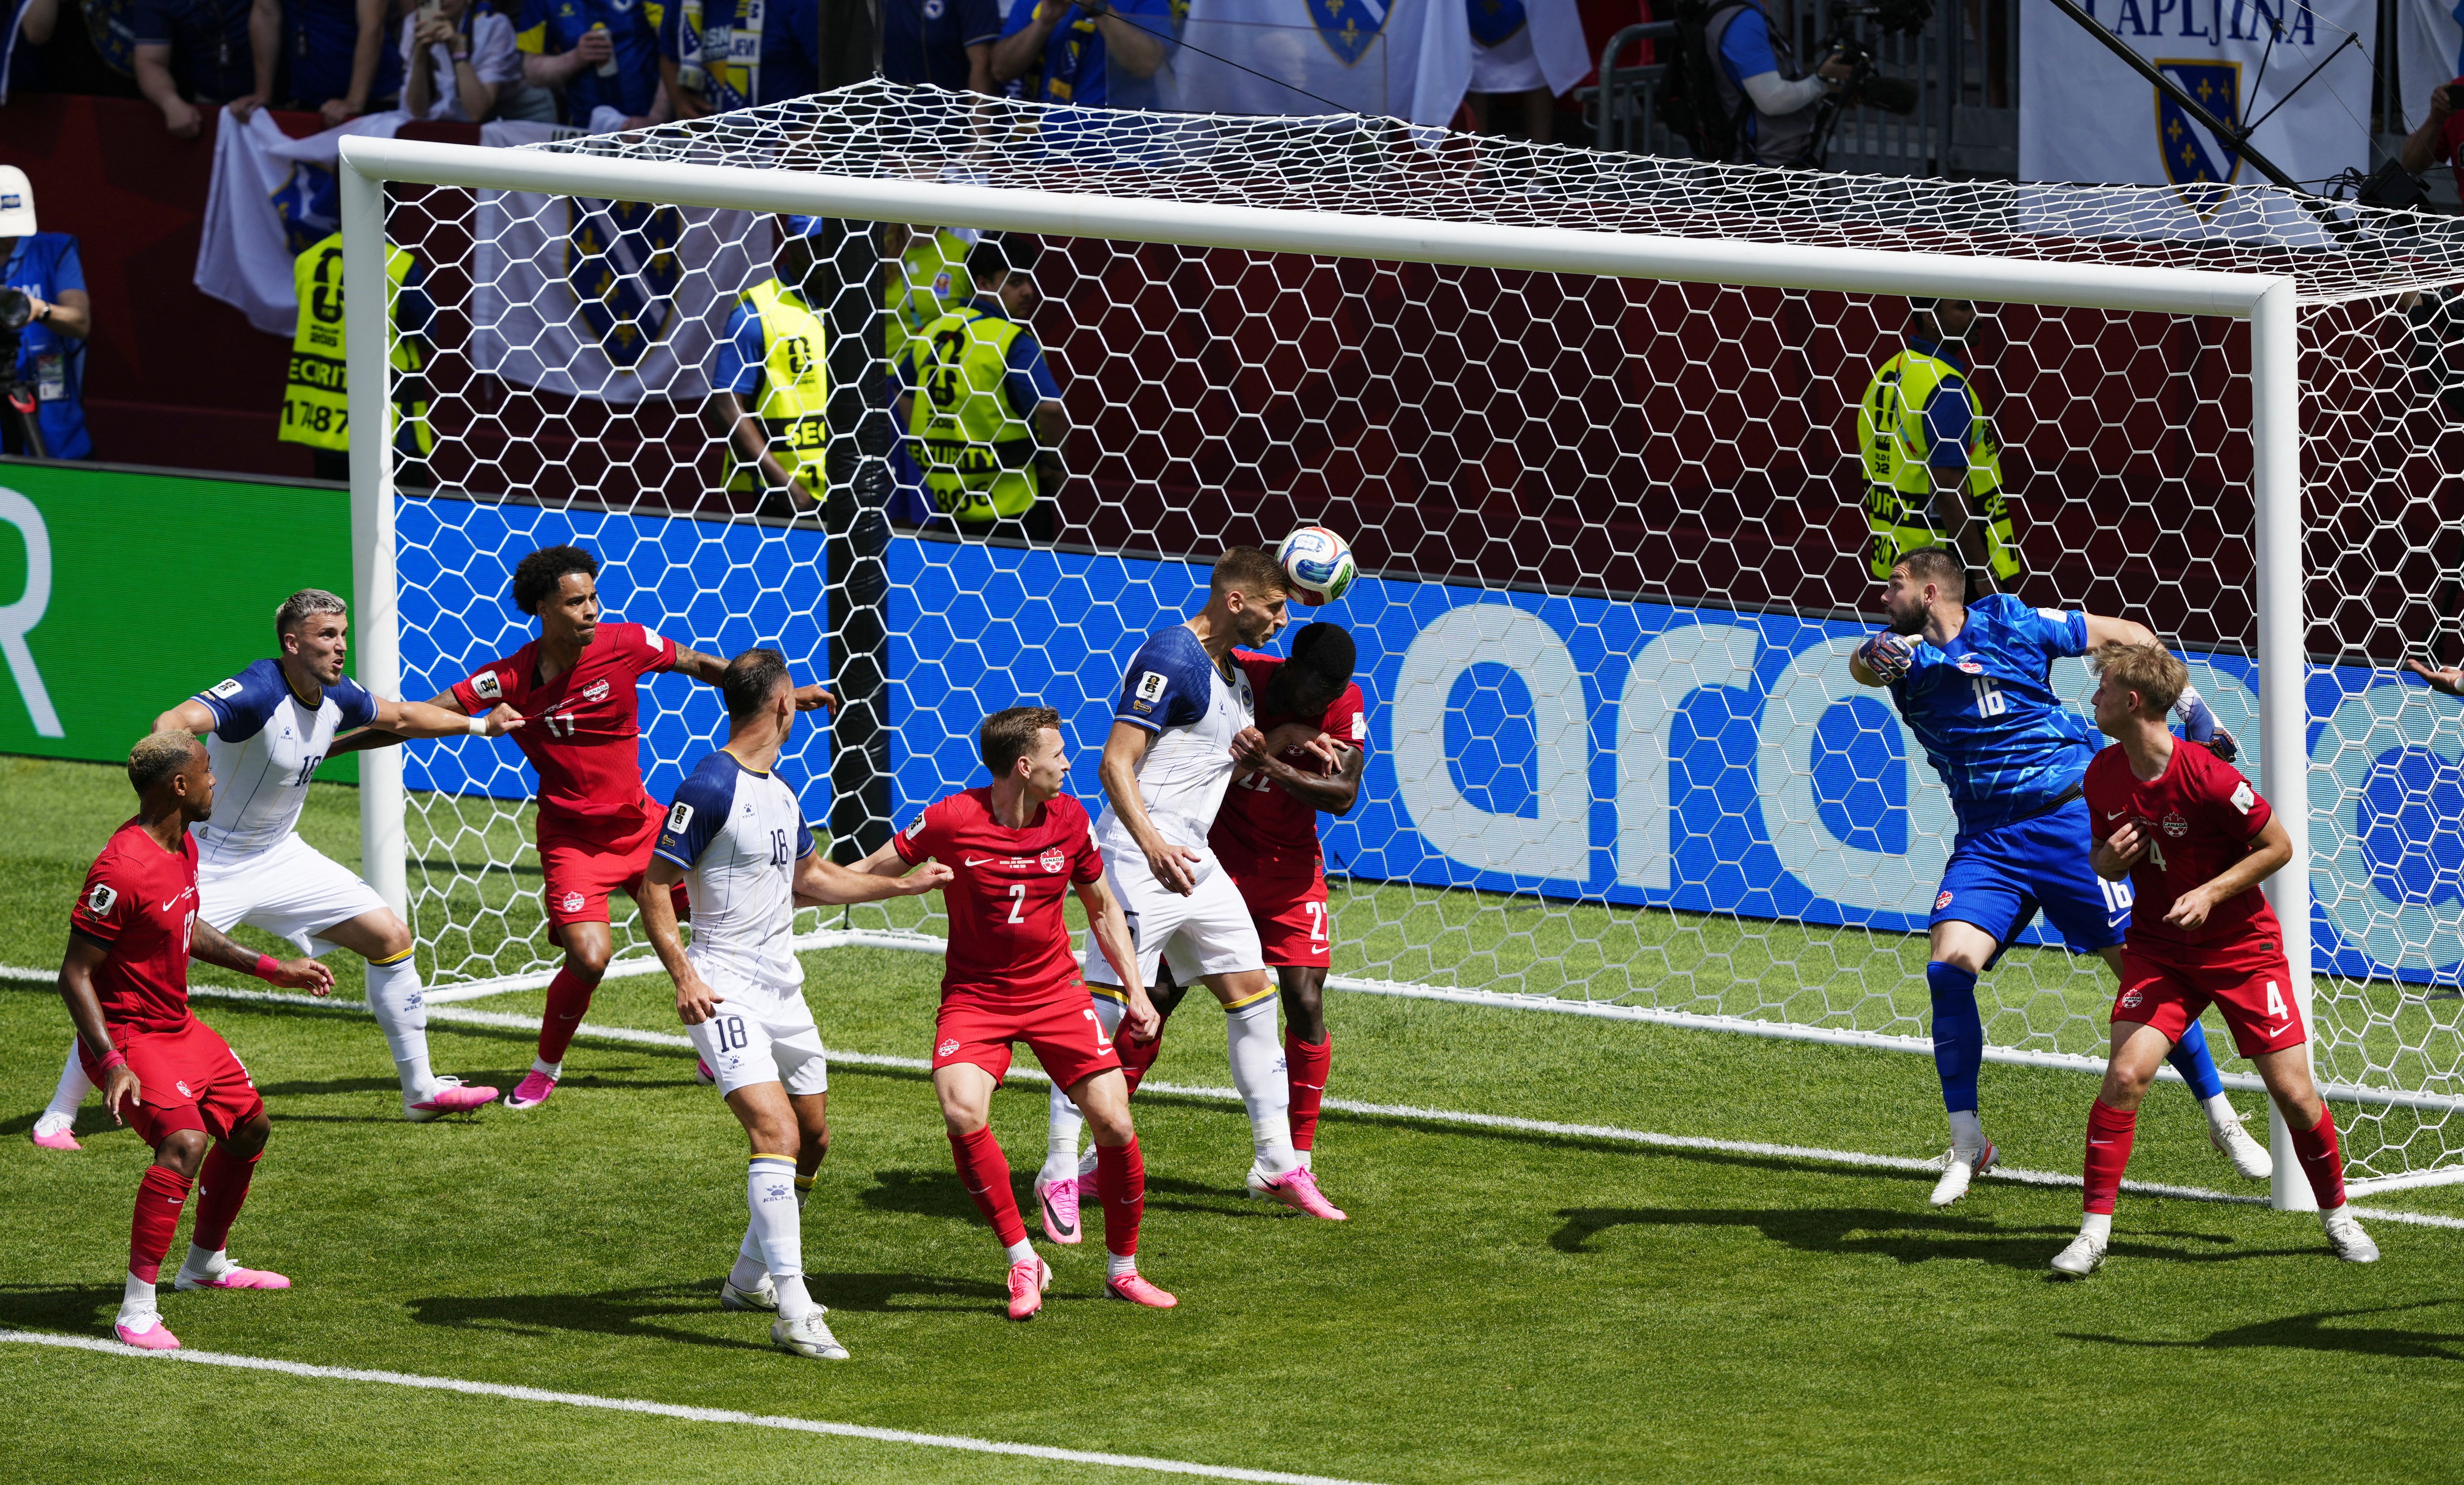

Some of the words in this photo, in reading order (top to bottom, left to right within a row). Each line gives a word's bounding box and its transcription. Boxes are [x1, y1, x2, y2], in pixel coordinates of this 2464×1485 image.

[2084, 0, 2316, 45] APLJINA
[584, 684, 609, 697] CANADA
[1972, 676, 2006, 719] 16
[544, 712, 574, 738] 17
[770, 828, 788, 866] 18
[2150, 837, 2167, 872] 4
[1008, 884, 1025, 924] 2
[2097, 875, 2133, 913] 16
[183, 909, 196, 954] 13
[2266, 981, 2288, 1020] 4
[715, 1017, 747, 1053] 18
[1082, 1008, 1110, 1045] 2
[729, 1062, 746, 1071] KELME
[763, 1195, 793, 1204] KELME
